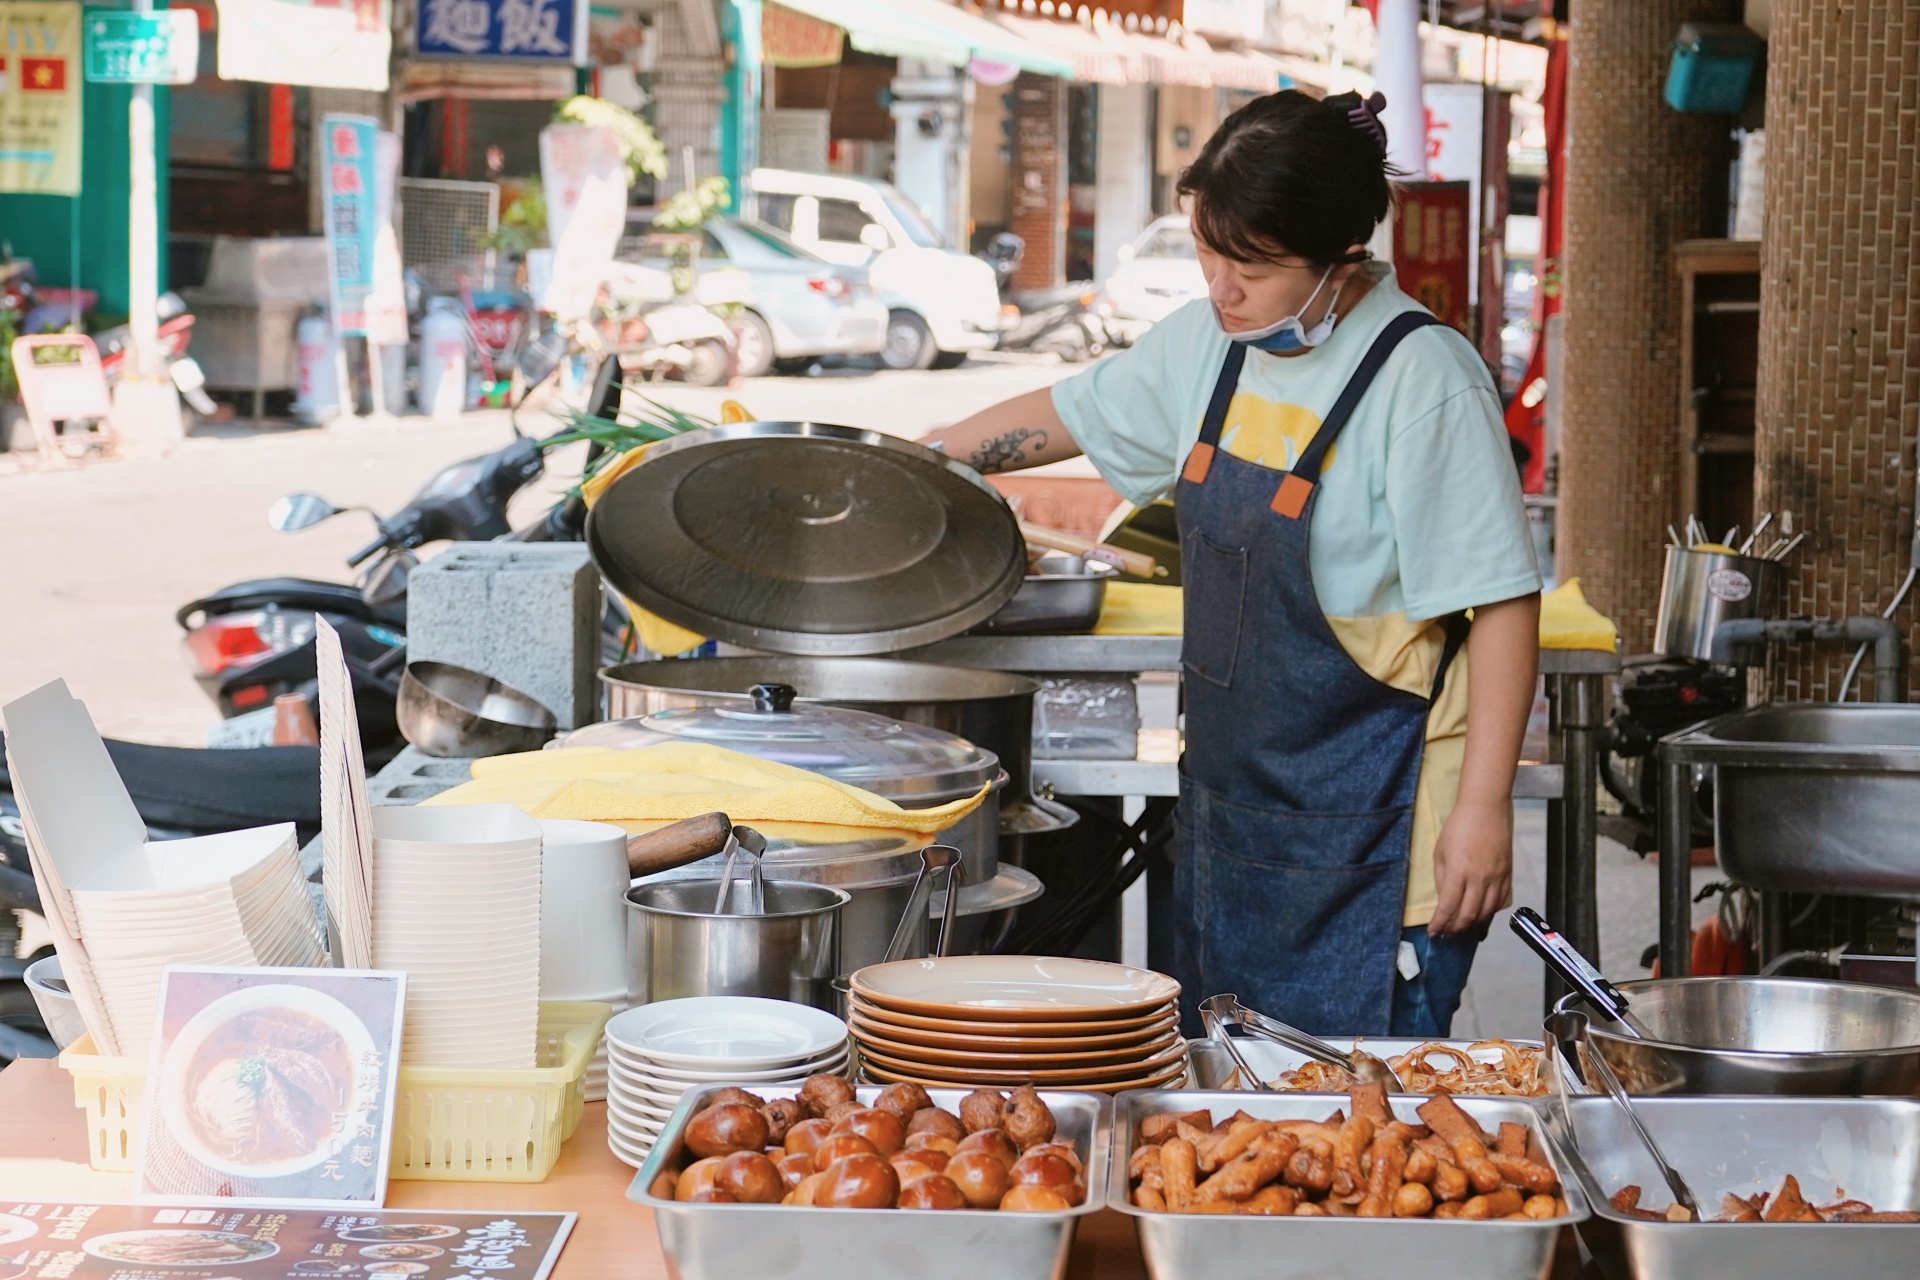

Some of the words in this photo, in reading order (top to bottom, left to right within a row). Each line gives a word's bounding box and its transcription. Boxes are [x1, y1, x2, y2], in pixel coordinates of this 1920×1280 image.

[350, 1050, 385, 1168] 紅燒牛肉麵
